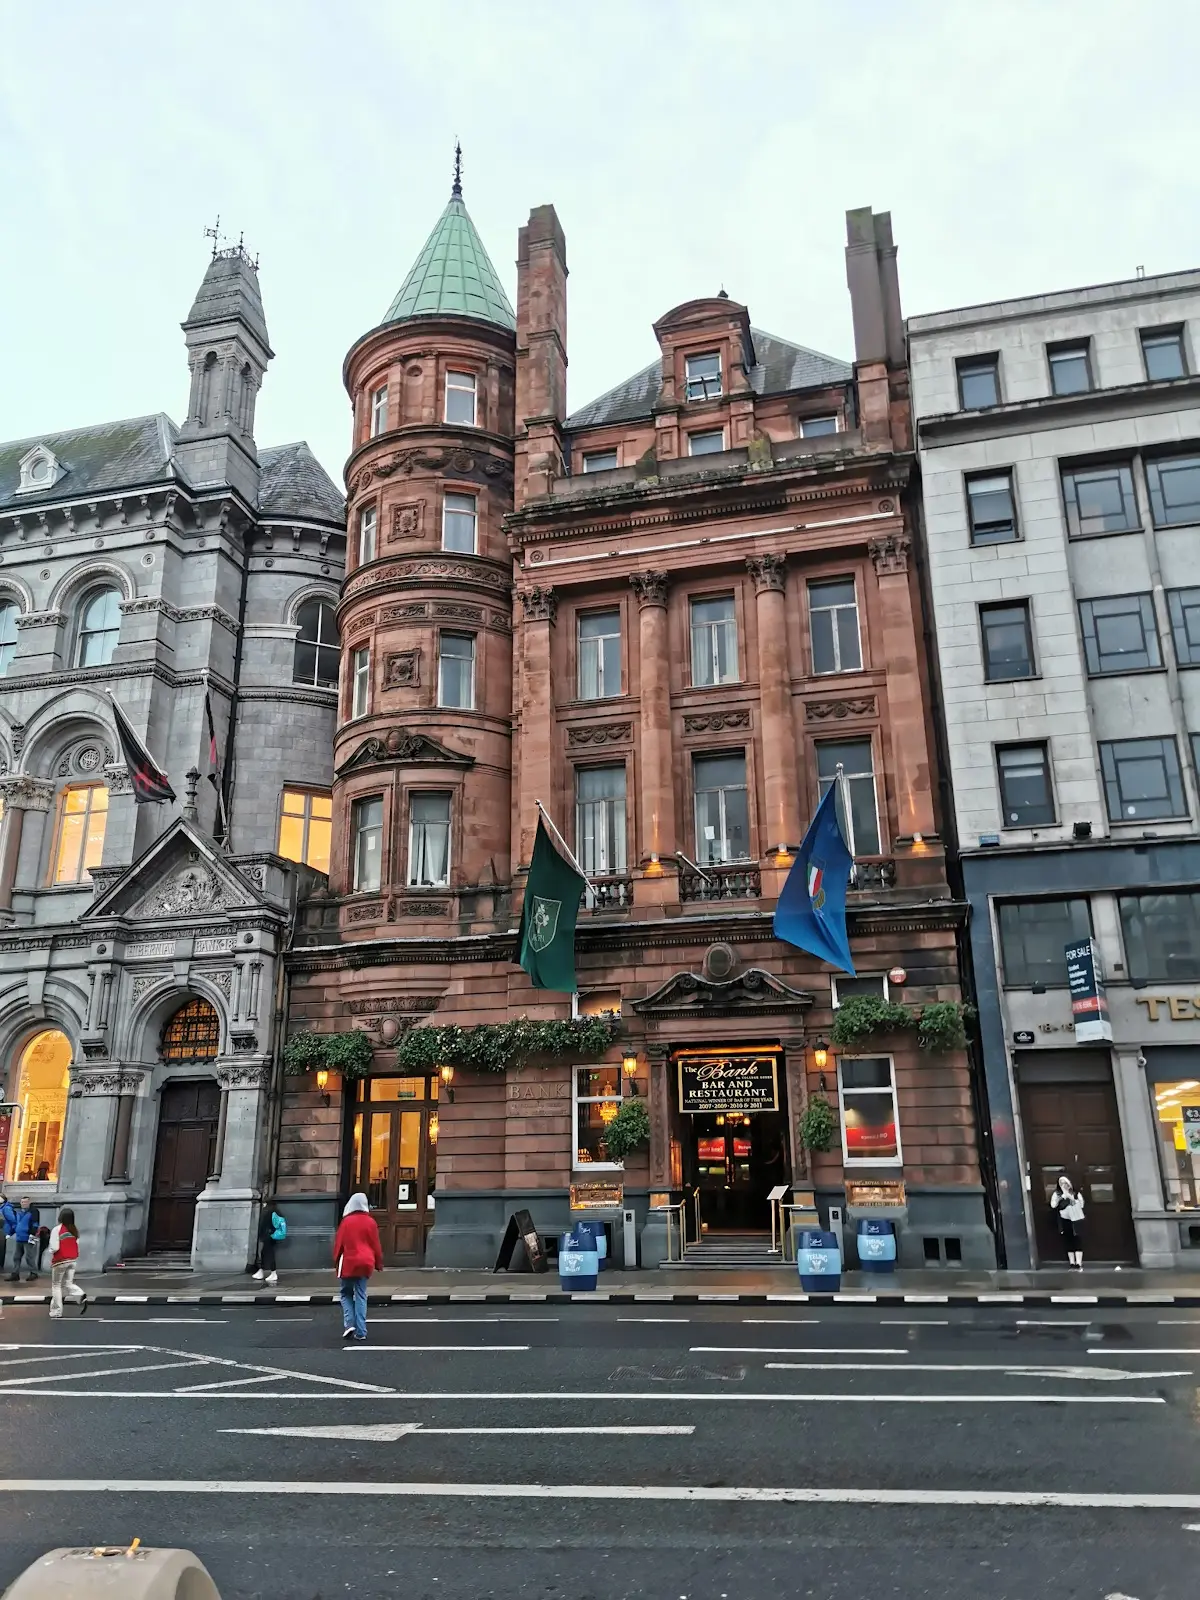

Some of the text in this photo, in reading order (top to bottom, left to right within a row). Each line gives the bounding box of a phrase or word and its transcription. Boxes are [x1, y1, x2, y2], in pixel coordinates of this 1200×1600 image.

[1066, 945, 1091, 960] FOR SALE
[696, 1061, 759, 1081] Bank
[510, 1083, 566, 1099] BANK
[702, 1080, 753, 1089] BAR AND
[689, 1088, 767, 1098] RESTAURANT
